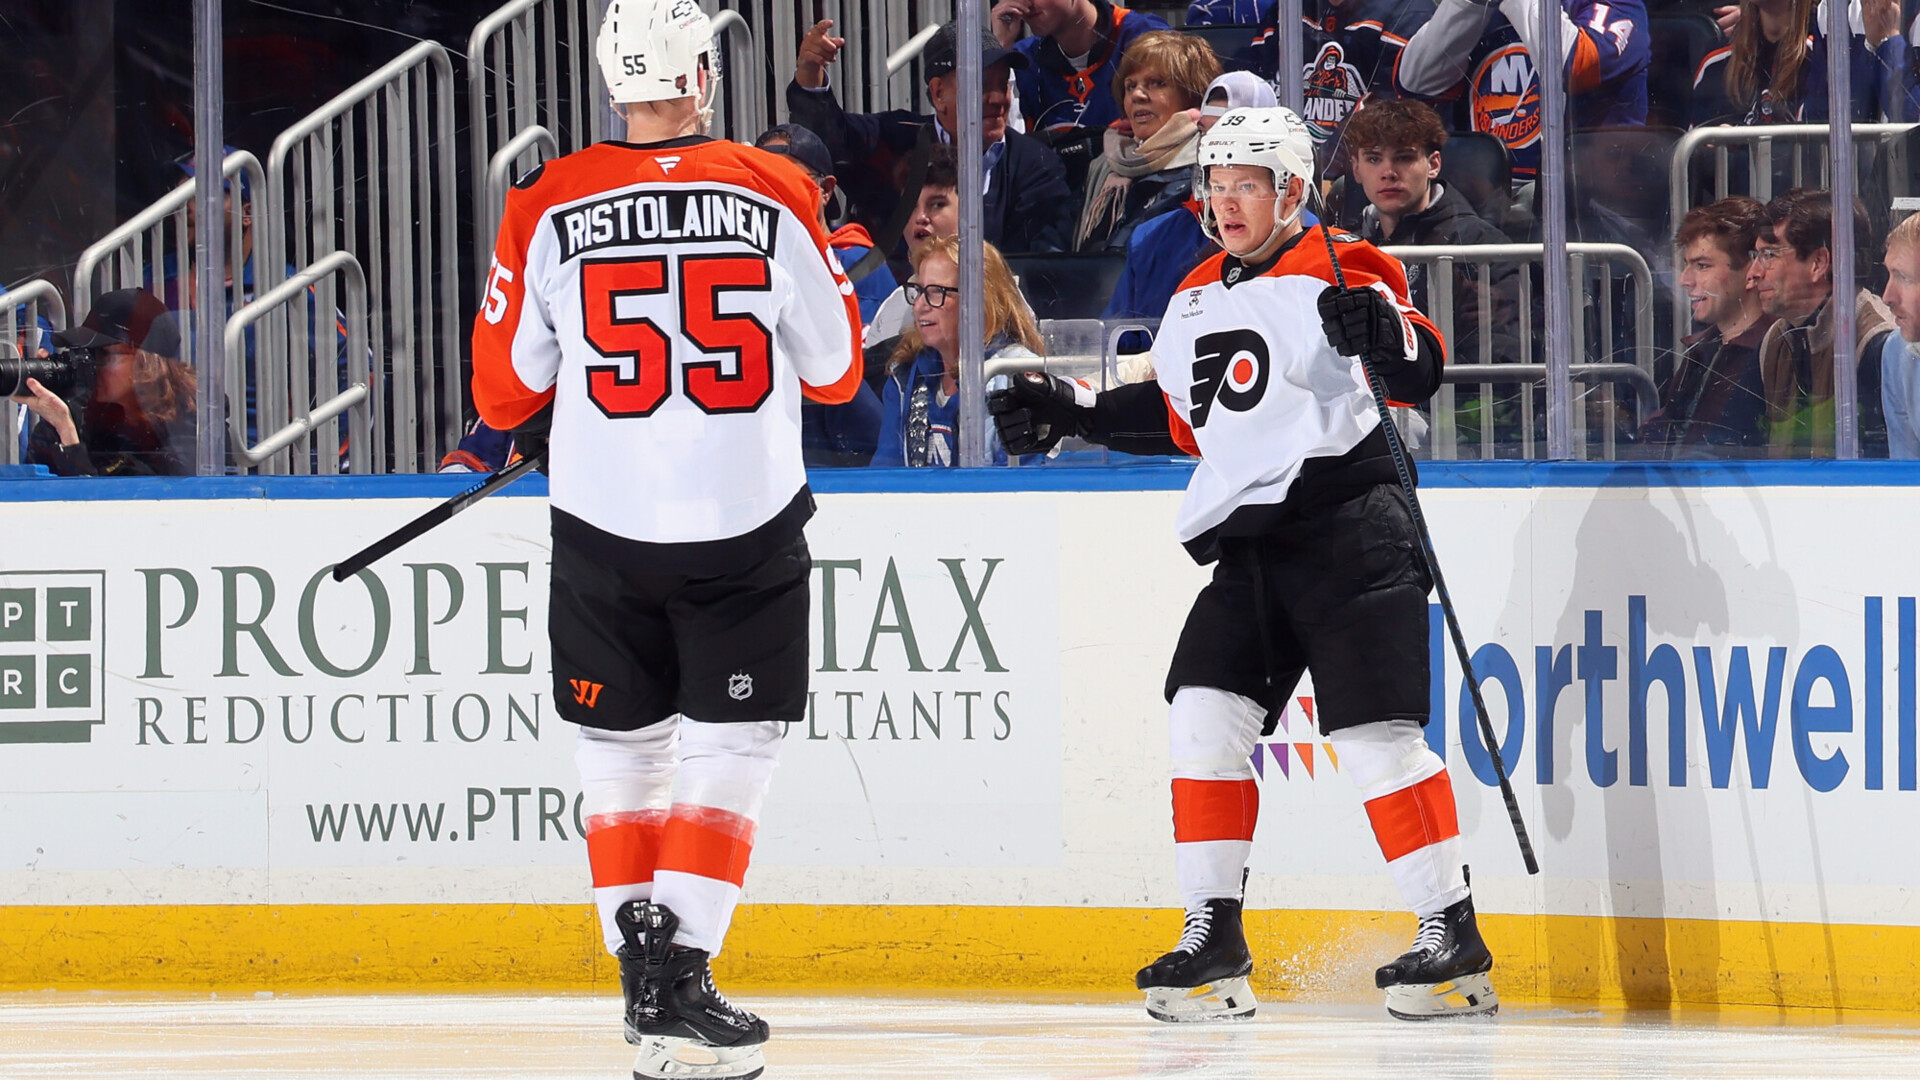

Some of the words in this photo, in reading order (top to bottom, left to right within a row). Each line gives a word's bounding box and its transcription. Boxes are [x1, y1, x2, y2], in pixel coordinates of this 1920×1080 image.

[622, 53, 647, 77] 55
[1221, 114, 1246, 127] 39
[564, 194, 770, 256] RISTOLAINEN
[580, 253, 774, 420] 55
[134, 560, 536, 680] PROPE
[809, 556, 1010, 673] TAX
[135, 692, 543, 745] REDUCTION
[781, 690, 1011, 741] LTANTS
